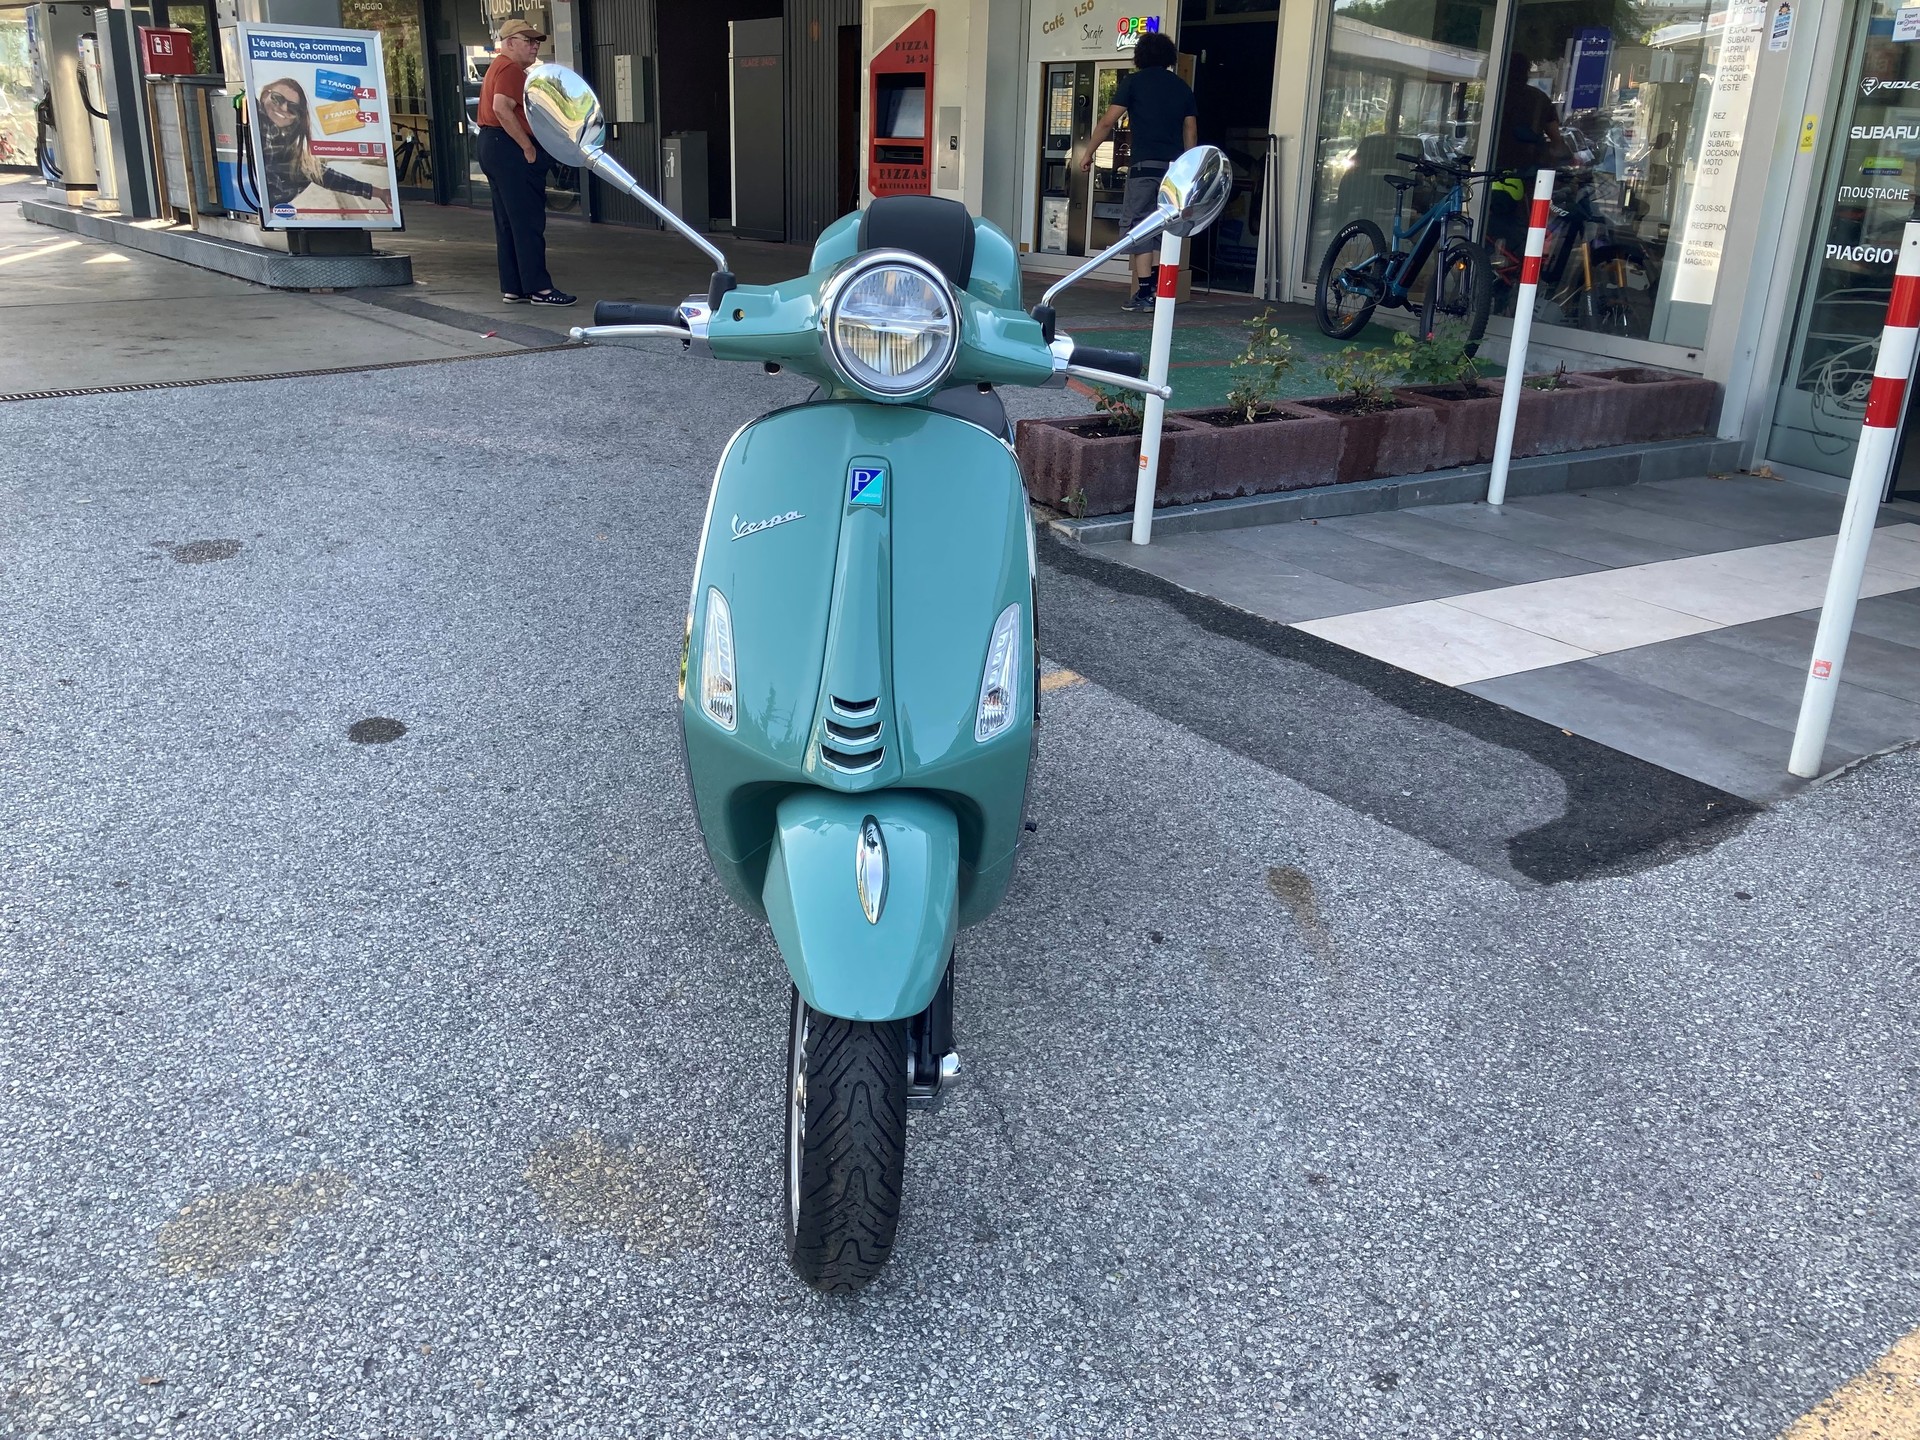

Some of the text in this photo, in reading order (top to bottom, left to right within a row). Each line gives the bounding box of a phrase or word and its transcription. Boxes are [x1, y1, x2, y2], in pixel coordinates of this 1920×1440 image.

[48, 4, 57, 16] 4
[83, 6, 92, 16] 3
[354, 2, 382, 10] PIAGGIO
[1042, 0, 1095, 34] Café 1.50
[1117, 16, 1160, 35] OPEN
[1728, 36, 1755, 44] SUBARU
[252, 38, 362, 53] L'évasion, ça commence
[895, 41, 928, 51] PIZZA
[254, 50, 270, 59] par
[271, 50, 288, 58] des
[357, 88, 370, 99] -4
[330, 108, 359, 120] TAMOIL
[360, 112, 372, 123] -5
[1712, 112, 1726, 120] REZ
[1850, 126, 1920, 140] SUBARU
[1708, 140, 1734, 148] SUBARU
[880, 168, 927, 180] PIZZAS
[1838, 186, 1910, 202] MOUSTACHE
[1694, 204, 1727, 213] SOUS-SOL
[1691, 222, 1728, 231] RECEPTION
[1688, 240, 1714, 248] ATELIER
[1684, 258, 1714, 266] MAGASIN
[731, 510, 806, 542] Vespa
